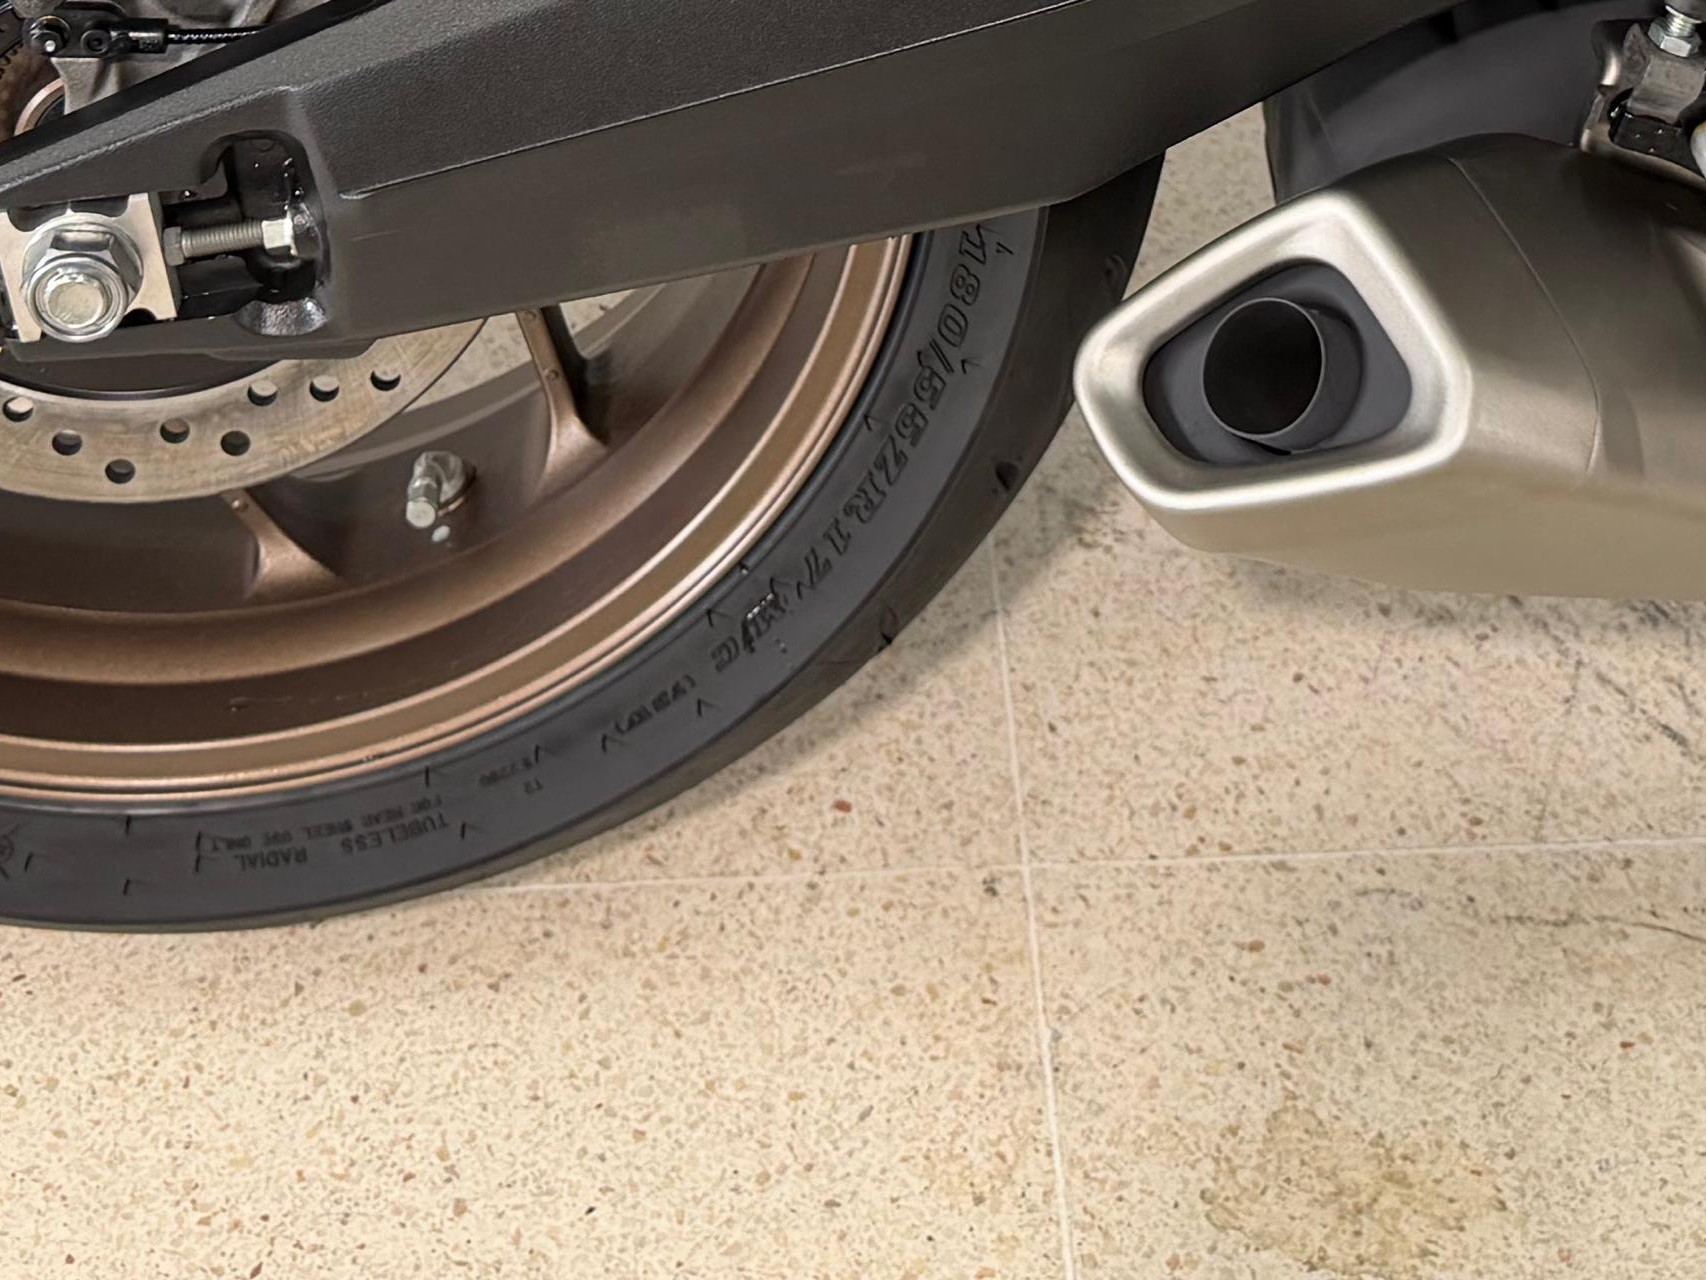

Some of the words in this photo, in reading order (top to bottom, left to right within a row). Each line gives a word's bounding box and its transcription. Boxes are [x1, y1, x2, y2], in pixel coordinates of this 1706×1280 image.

[803, 223, 991, 590] 180/55ZR17
[341, 814, 449, 855] TUBELESS
[236, 844, 308, 874] RADIAL
